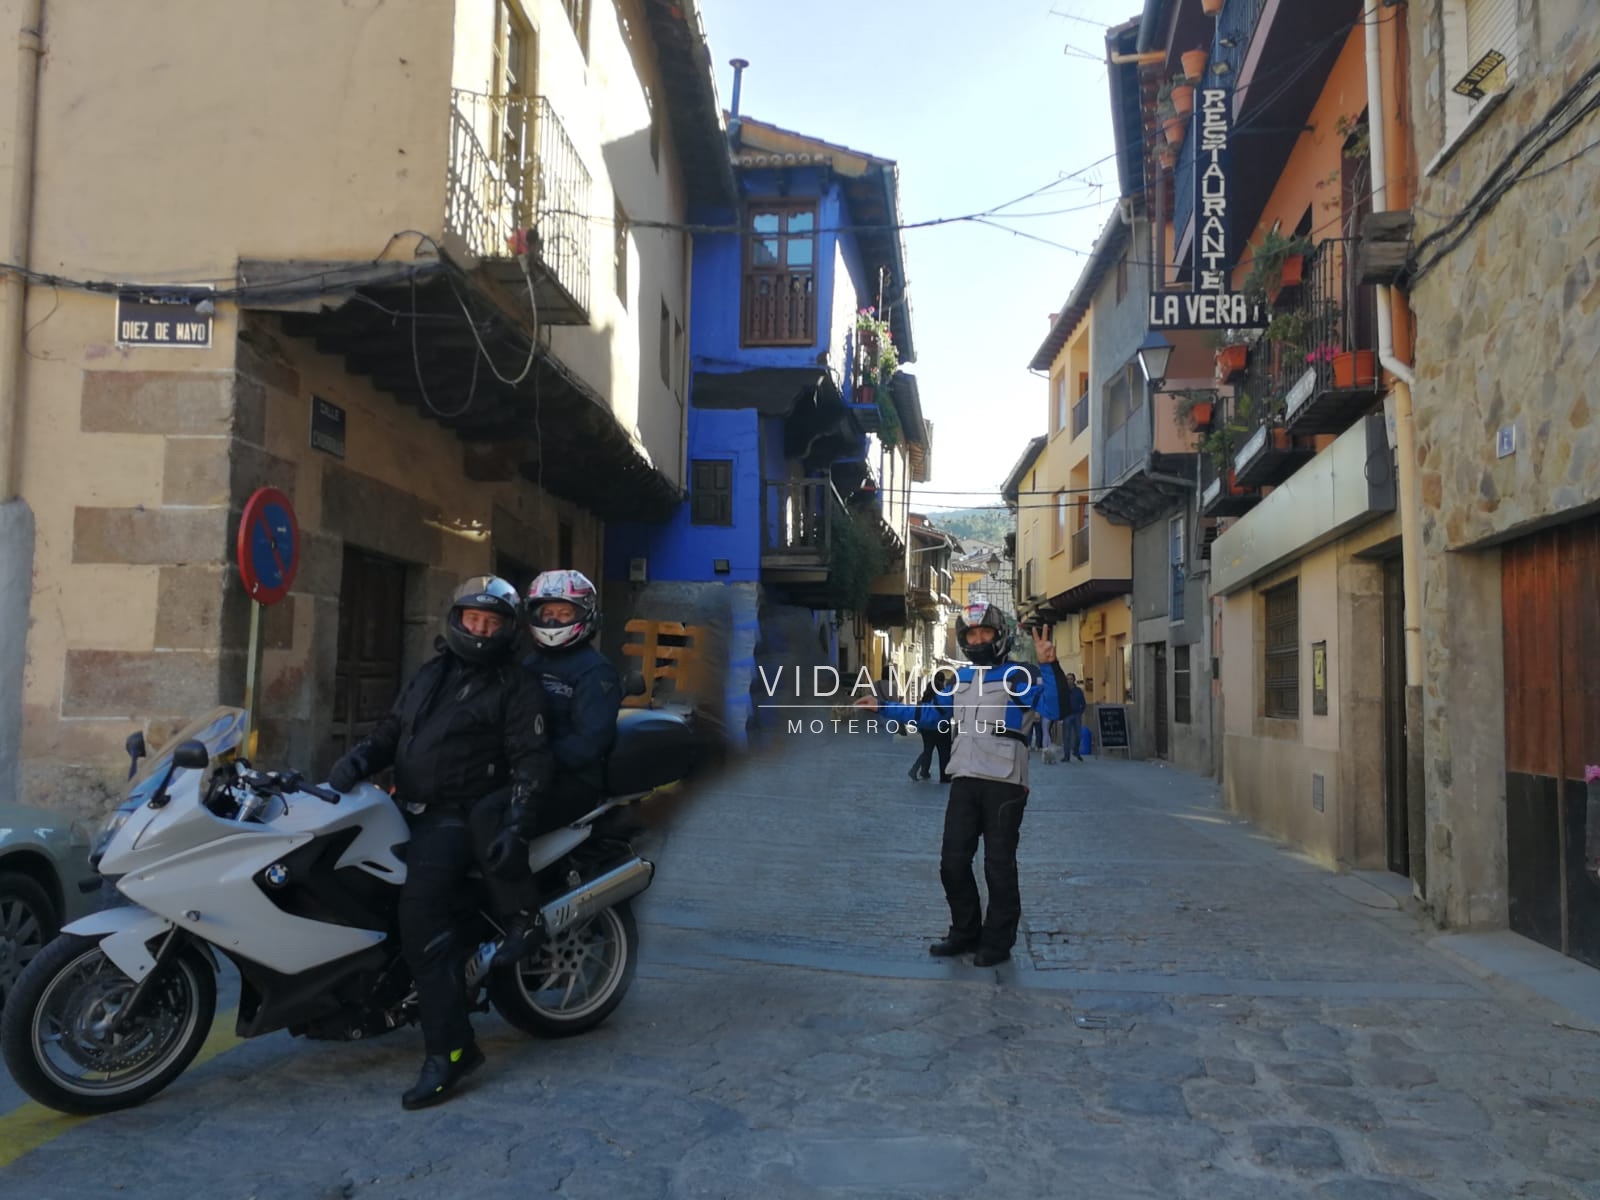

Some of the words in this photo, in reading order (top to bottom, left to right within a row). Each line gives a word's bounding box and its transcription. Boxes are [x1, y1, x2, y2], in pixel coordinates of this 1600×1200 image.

[1455, 80, 1476, 95] SE
[1467, 50, 1505, 81] VENDE
[1201, 89, 1228, 290] RESTAURANTE
[1150, 294, 1179, 326] LA
[122, 320, 149, 341] DIEZ
[154, 321, 171, 341] DE
[176, 321, 207, 342] MAYO
